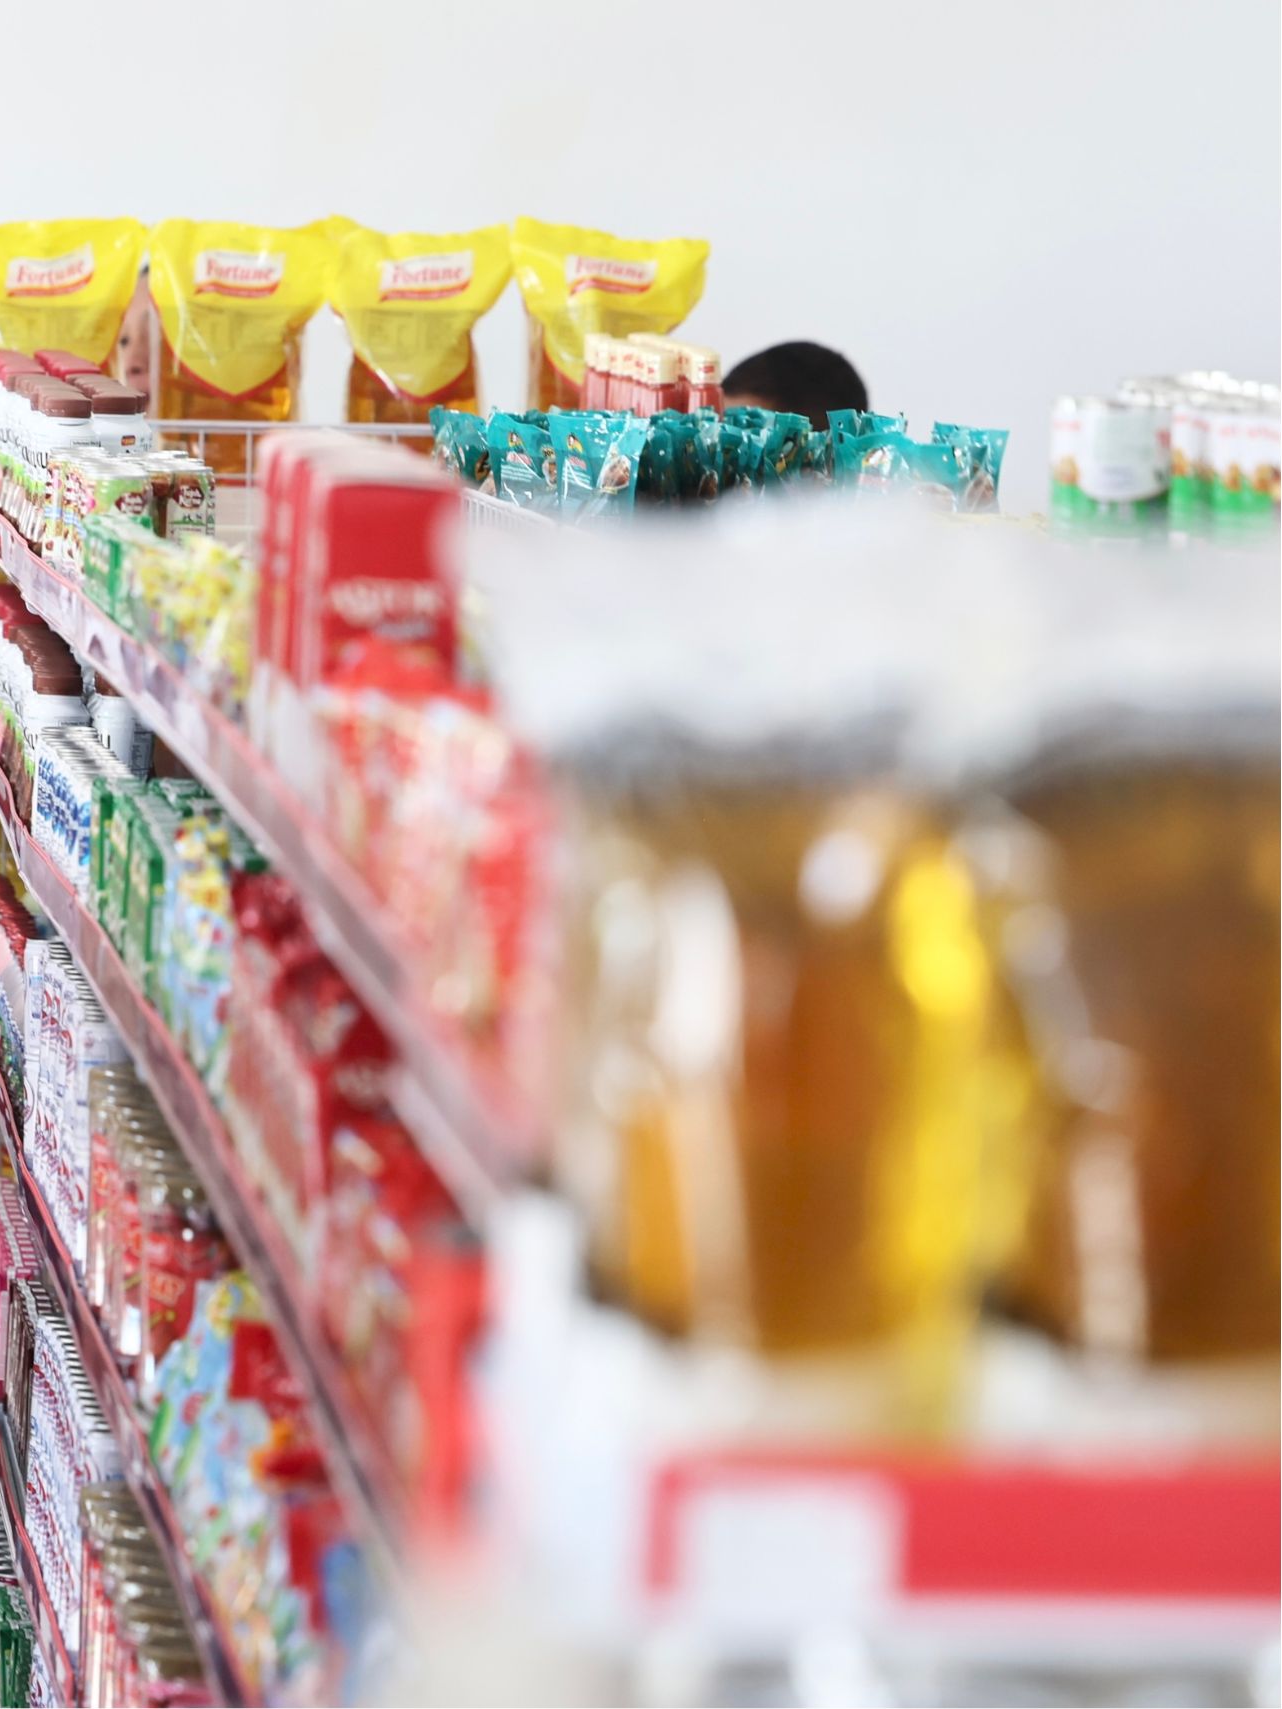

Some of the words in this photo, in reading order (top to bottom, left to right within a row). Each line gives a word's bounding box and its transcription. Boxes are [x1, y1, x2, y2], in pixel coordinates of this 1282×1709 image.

[16, 259, 85, 286] Fortune
[206, 257, 275, 281] Fortune
[392, 263, 464, 284] Fortune
[576, 255, 643, 281] Fortune
